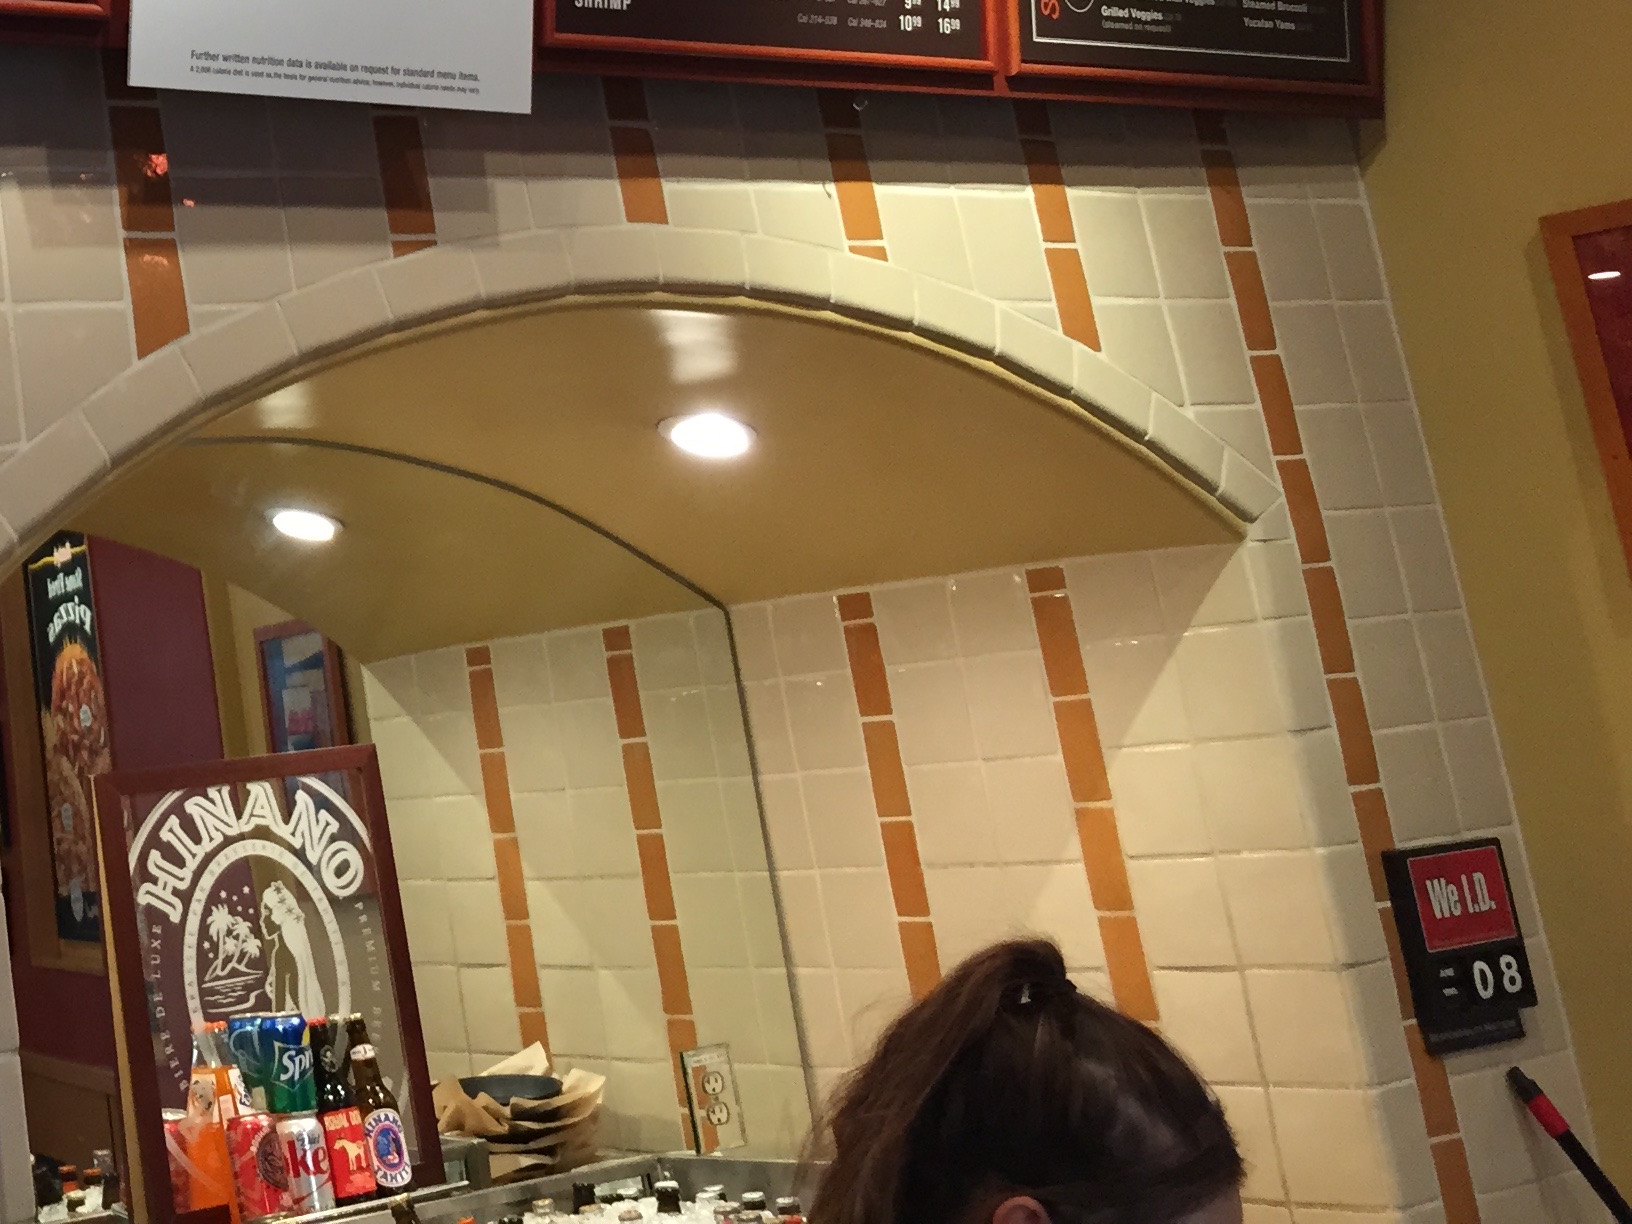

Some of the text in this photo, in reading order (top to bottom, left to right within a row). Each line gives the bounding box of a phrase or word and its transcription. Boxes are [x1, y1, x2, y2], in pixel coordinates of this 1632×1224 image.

[137, 781, 363, 923] HINANO
[1426, 877, 1461, 919] We
[355, 901, 382, 991] PREMIUM
